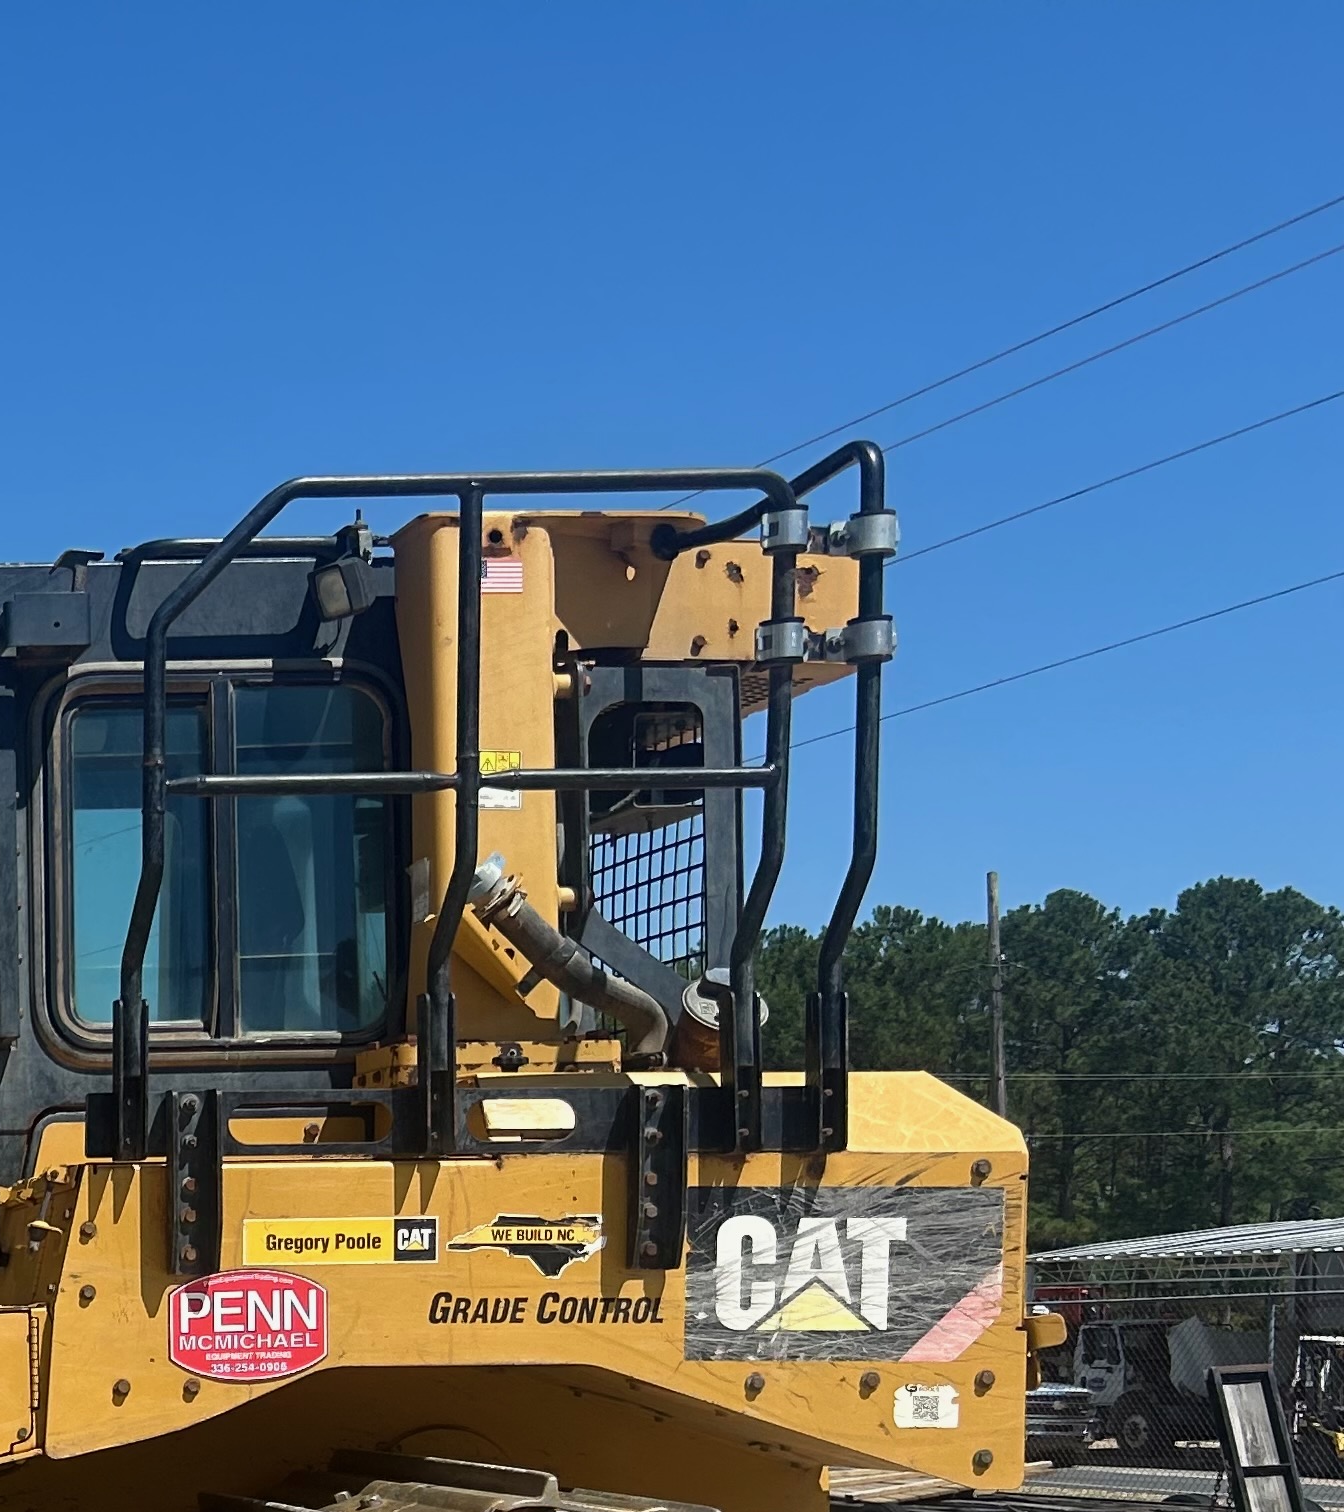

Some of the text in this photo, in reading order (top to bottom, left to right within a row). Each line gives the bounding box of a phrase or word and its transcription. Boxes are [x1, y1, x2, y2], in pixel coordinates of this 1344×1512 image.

[265, 1232, 382, 1254] Gregory Poole
[397, 1228, 432, 1251] CAT
[491, 1228, 575, 1241] WE BUILD NC
[714, 1214, 908, 1332] CAT
[179, 1288, 318, 1334] PENN
[179, 1332, 319, 1351] MCMICHAEL
